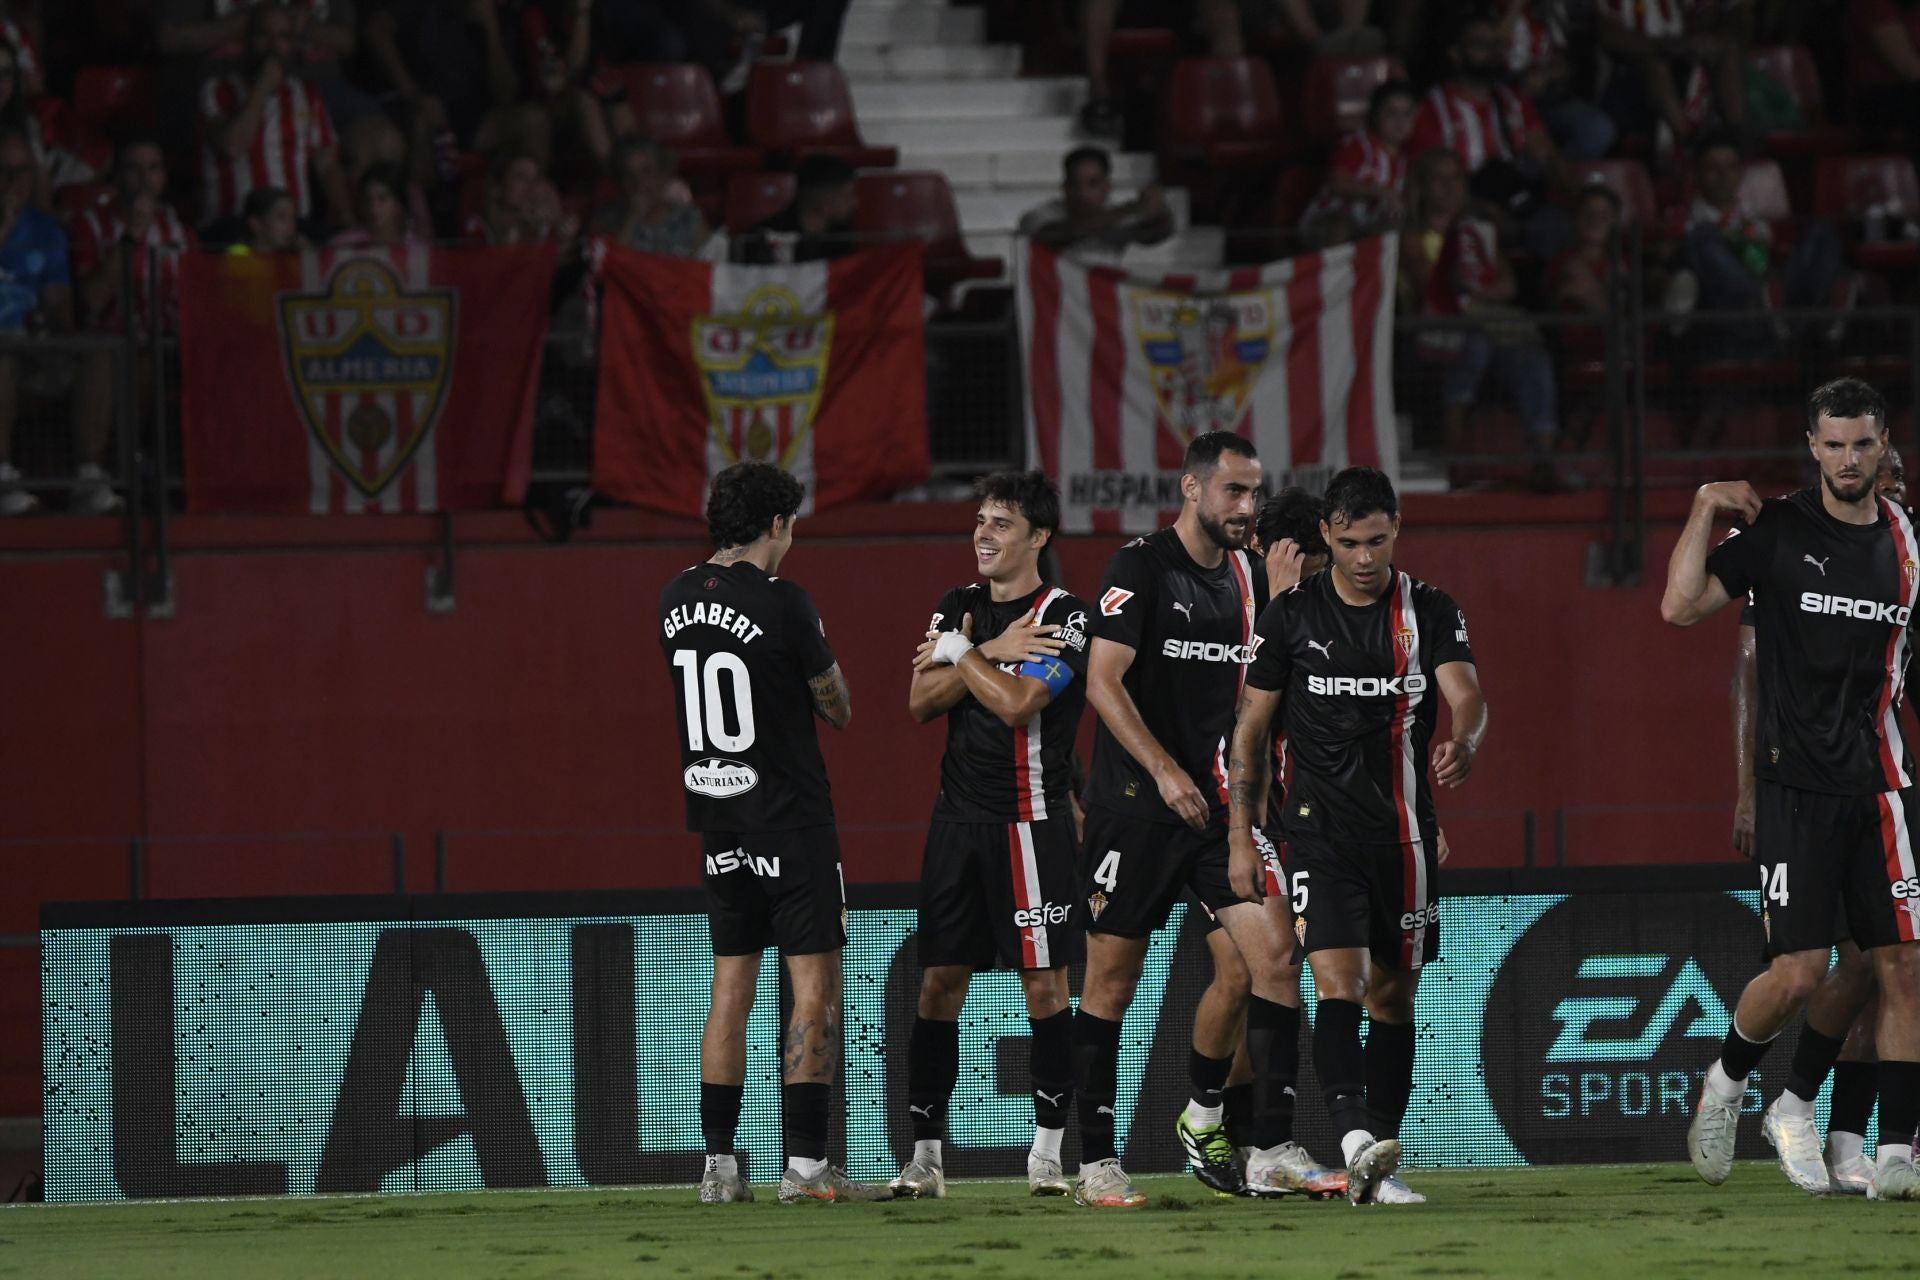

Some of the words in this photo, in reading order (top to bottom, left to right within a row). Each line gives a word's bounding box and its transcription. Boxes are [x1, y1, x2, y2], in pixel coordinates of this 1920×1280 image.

[305, 313, 337, 338] U
[396, 313, 429, 338] D
[307, 357, 433, 381] ALMERIA
[664, 602, 764, 645] GELABERT
[1800, 591, 1911, 627] SIROKO
[1162, 638, 1252, 664] SIROKO
[673, 649, 756, 753] 10
[1307, 673, 1427, 697] SIROKO
[690, 771, 751, 787] ASTURIANA
[1093, 850, 1122, 893] 4
[1292, 870, 1310, 914] 5
[1014, 901, 1073, 928] esfer
[1545, 952, 1734, 1063] EA
[110, 903, 1345, 1195] LALGA
[1540, 1067, 1765, 1118] SPORS
